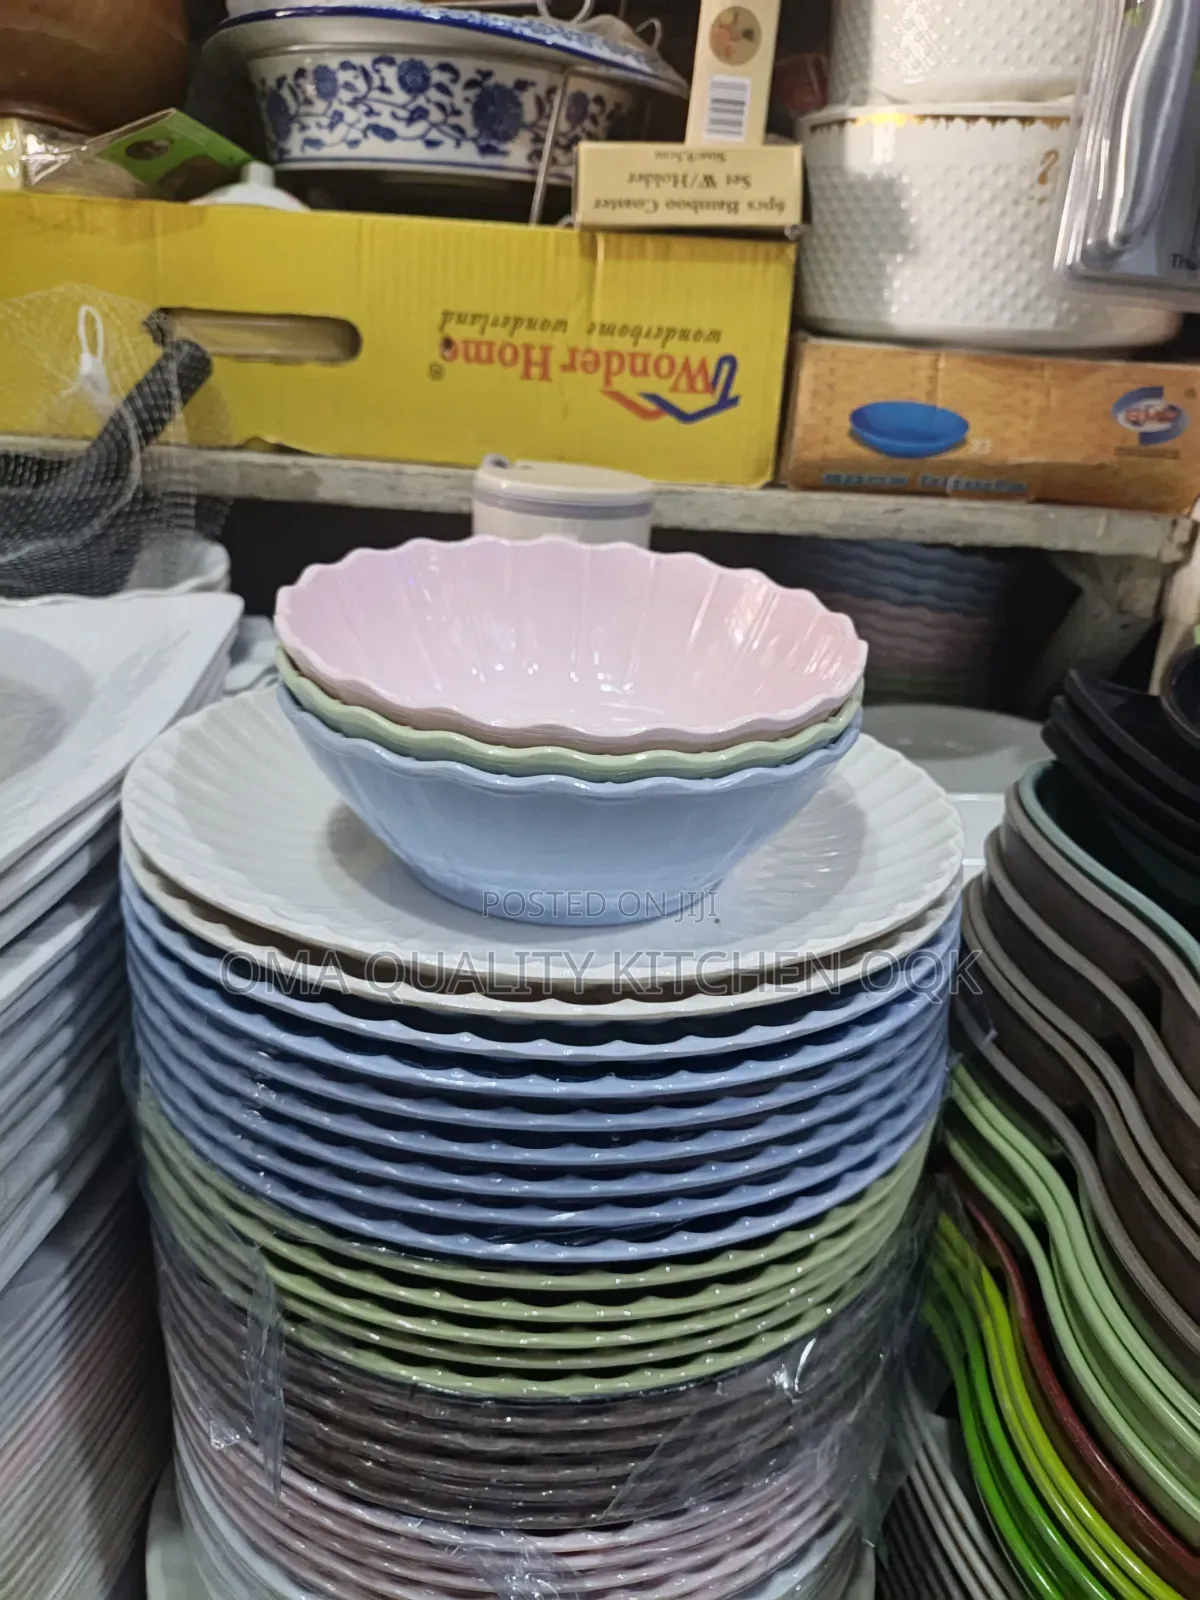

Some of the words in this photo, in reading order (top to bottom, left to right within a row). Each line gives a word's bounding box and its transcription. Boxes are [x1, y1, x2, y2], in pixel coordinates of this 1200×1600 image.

[626, 171, 717, 189] W/Holder
[725, 173, 753, 190] Set
[593, 197, 660, 214] Coaster
[664, 198, 740, 216] Bamboo
[746, 196, 786, 216] 6pcs
[436, 308, 570, 337] wonderland
[438, 335, 553, 382] Home
[559, 346, 715, 395] Wonder
